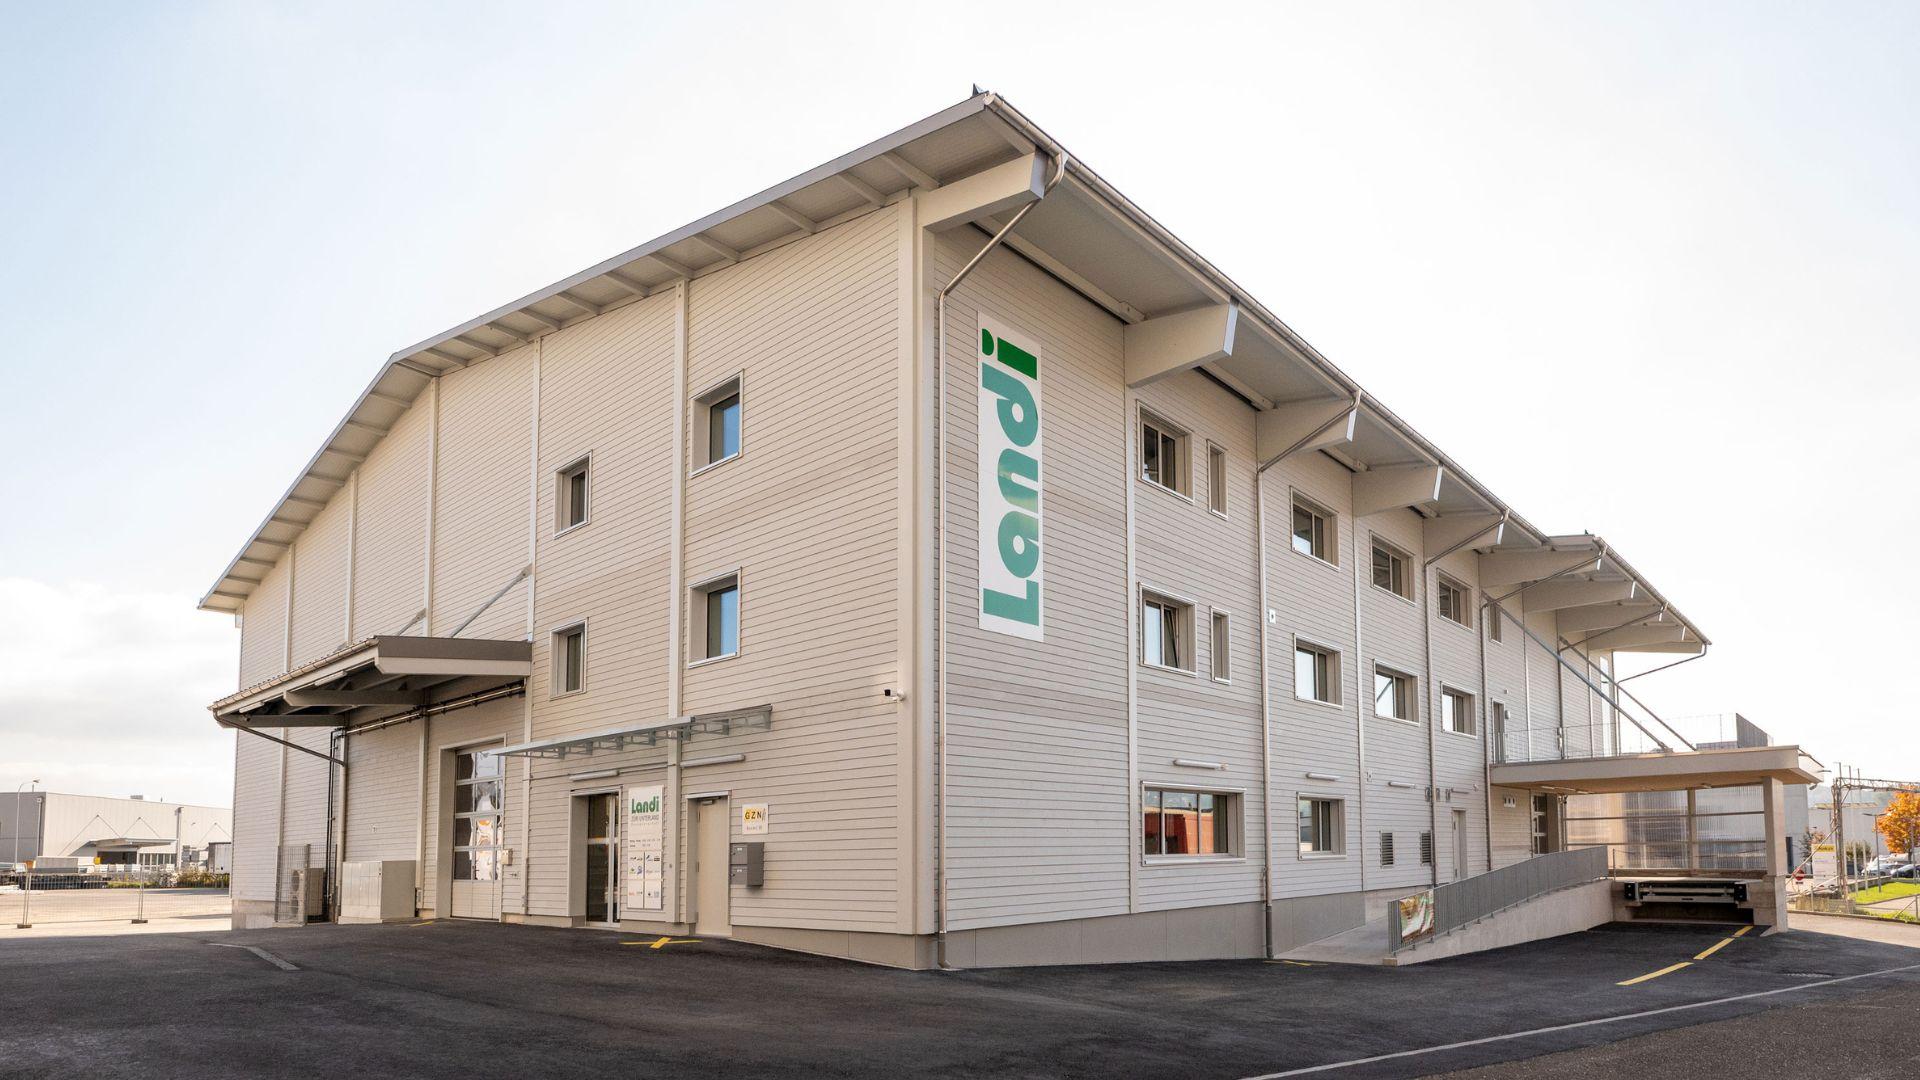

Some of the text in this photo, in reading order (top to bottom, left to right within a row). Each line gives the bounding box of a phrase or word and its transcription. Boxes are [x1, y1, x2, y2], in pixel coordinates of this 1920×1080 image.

[982, 328, 1040, 627] Landi
[631, 796, 659, 814] Landi
[744, 811, 762, 820] GZN
